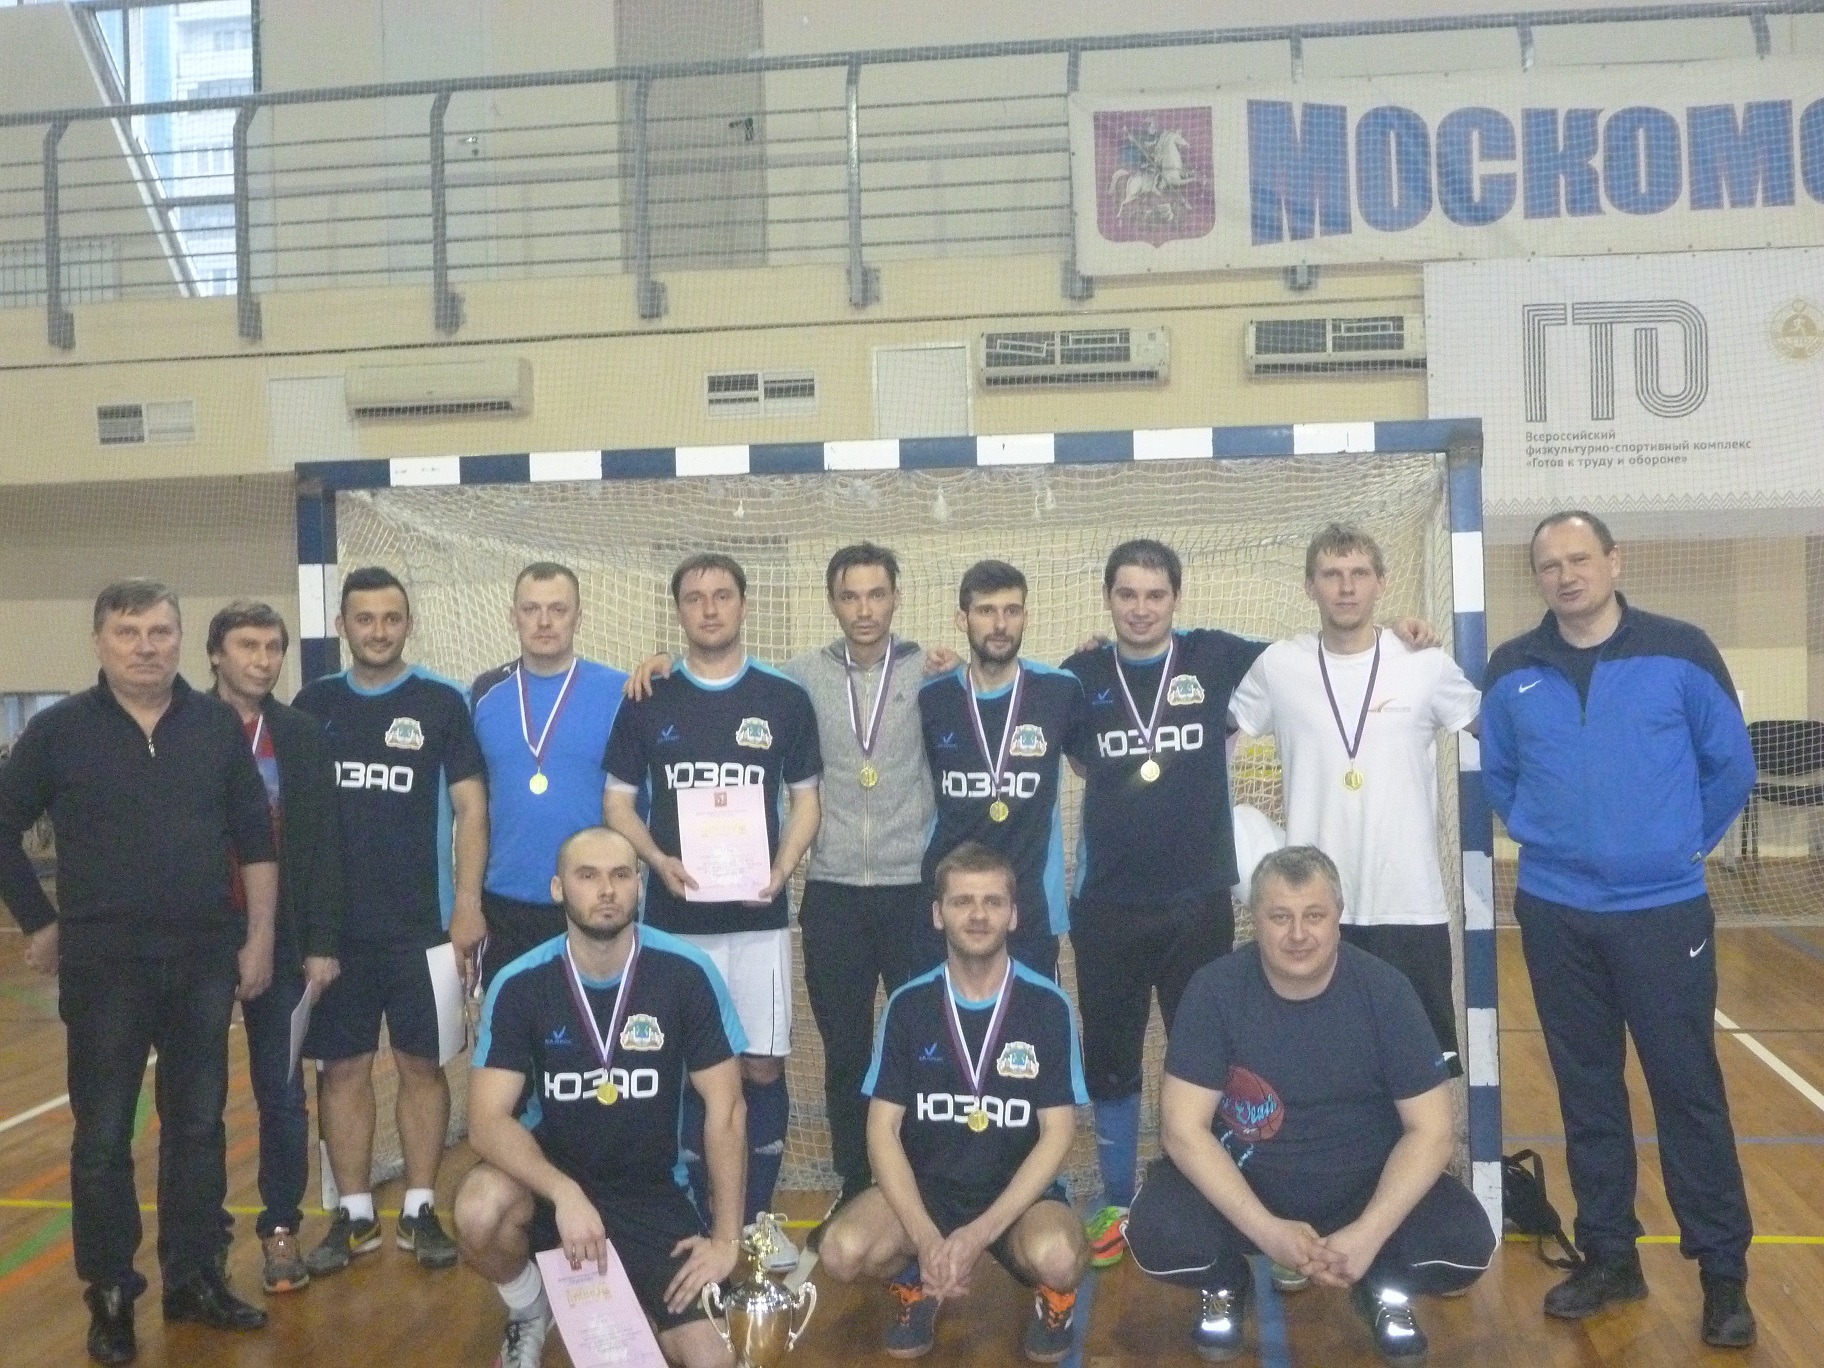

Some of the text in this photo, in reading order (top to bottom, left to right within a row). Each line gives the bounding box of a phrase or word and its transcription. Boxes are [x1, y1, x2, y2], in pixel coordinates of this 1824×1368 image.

[1522, 299, 1709, 423] ГТО
[1525, 429, 1616, 443] Всероссийский
[1525, 440, 1752, 457] физкультурно-спортивный комплекс
[1526, 455, 1688, 469] «Готов к труду и обороне»
[664, 761, 765, 789] ЮЗАО
[941, 769, 1041, 799] ЮЗАО
[544, 1067, 659, 1101] ЮЗАО
[916, 1092, 1031, 1128] ЮЗАО
